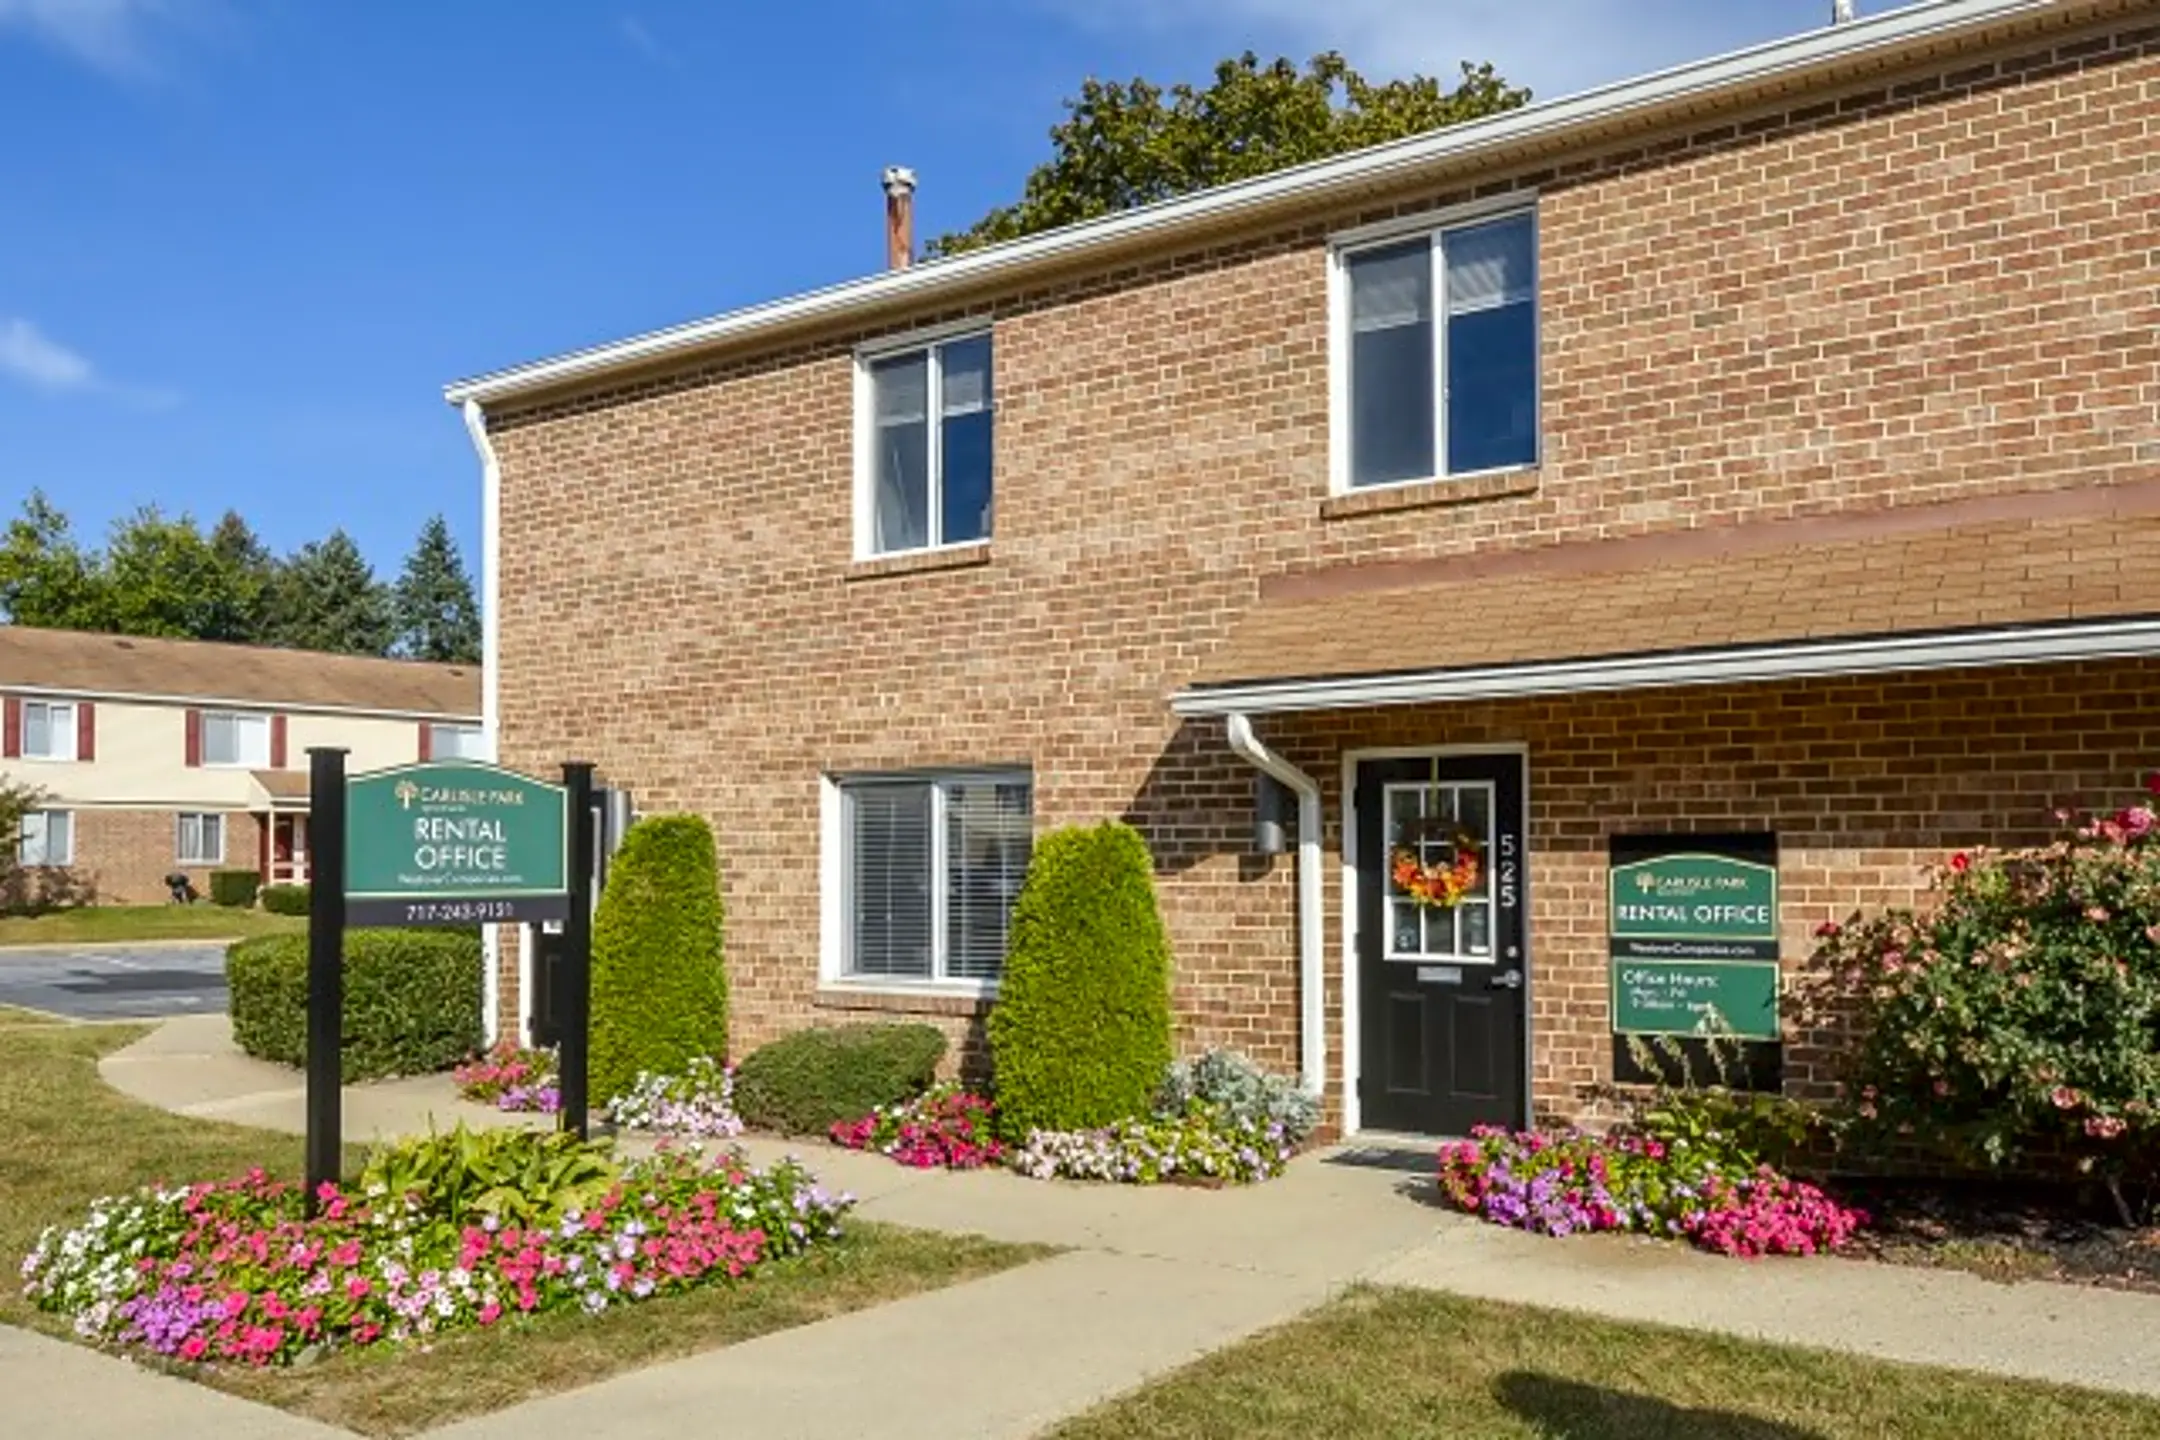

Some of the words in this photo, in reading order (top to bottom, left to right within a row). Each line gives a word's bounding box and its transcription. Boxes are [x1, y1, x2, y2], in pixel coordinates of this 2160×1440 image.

[414, 817, 506, 843] RENTAL
[414, 845, 506, 870] OFFICE
[1501, 834, 1516, 907] 525
[1618, 904, 1687, 922] RENTAL
[1693, 905, 1770, 924] OFFICE
[1622, 969, 1666, 985] Office
